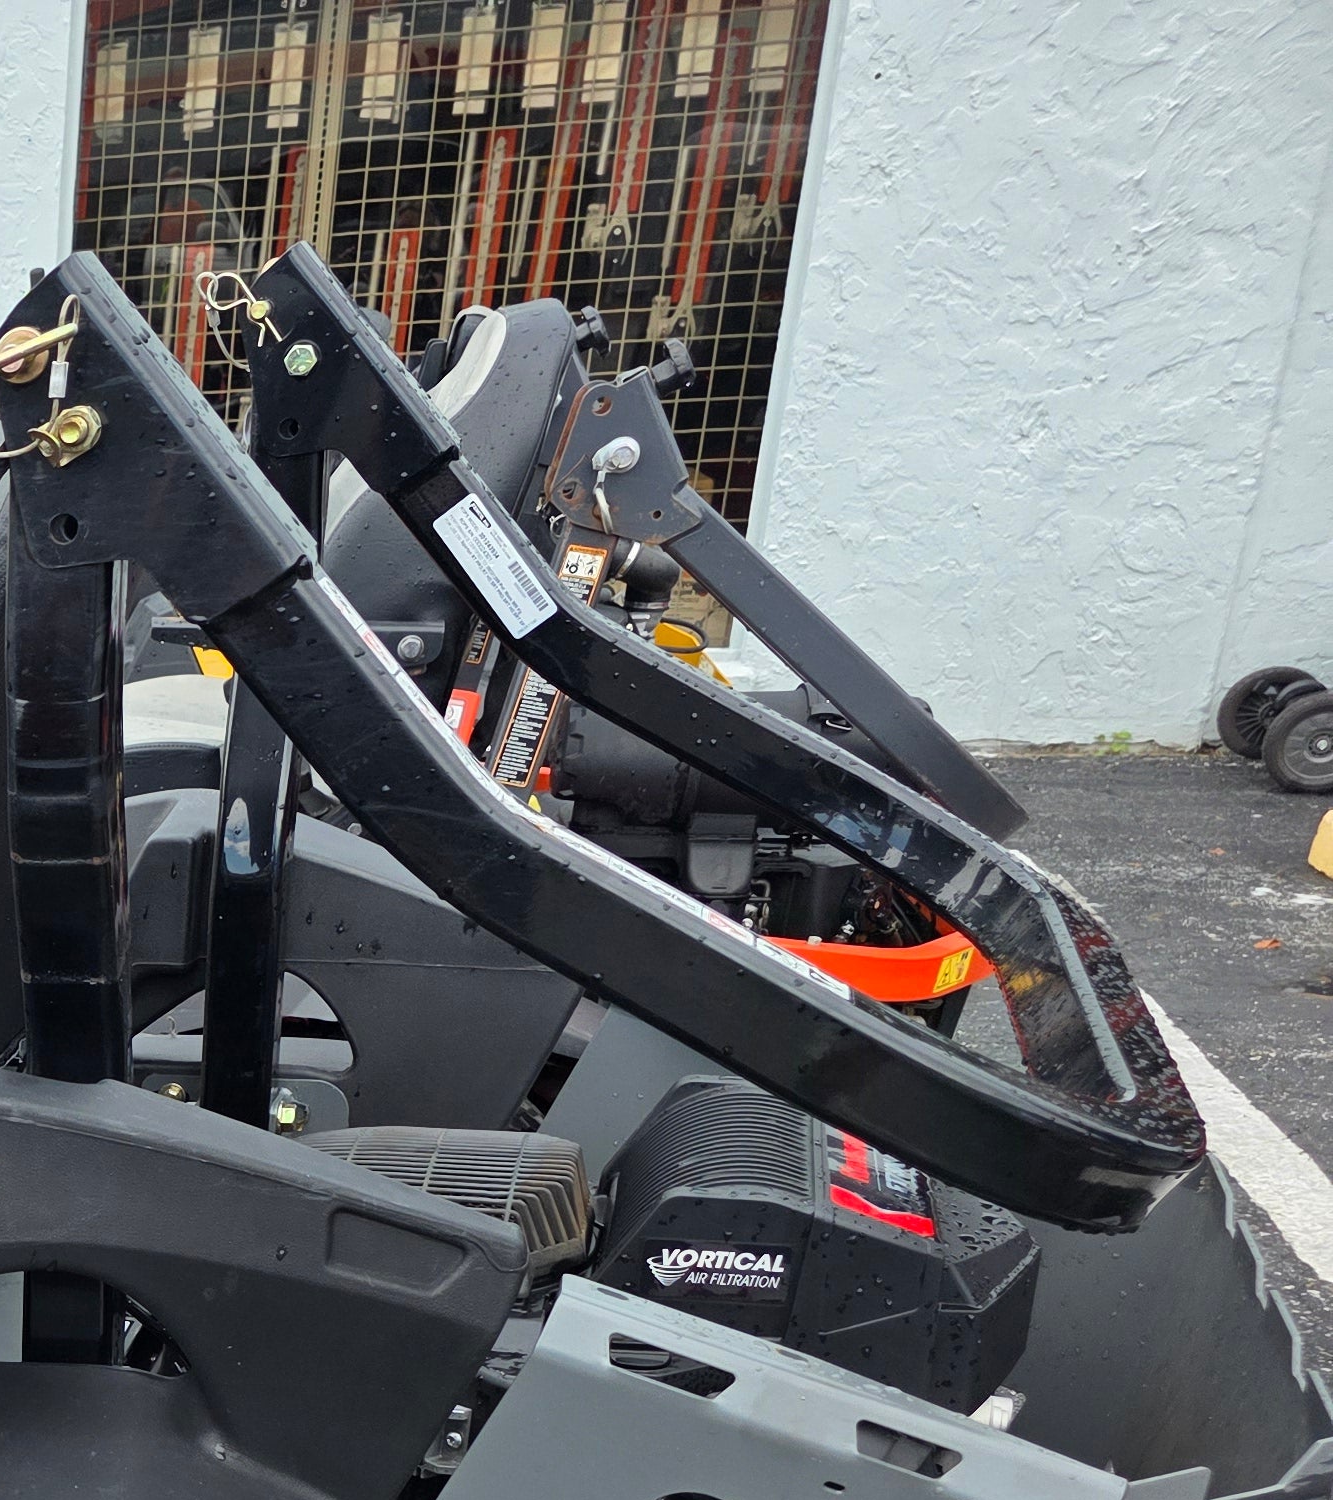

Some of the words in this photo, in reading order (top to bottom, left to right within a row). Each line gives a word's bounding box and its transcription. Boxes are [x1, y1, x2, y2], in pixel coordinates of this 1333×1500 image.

[661, 1248, 785, 1273] VORTICAL
[685, 1271, 706, 1284] AIR
[709, 1272, 780, 1289] FILTRATION
